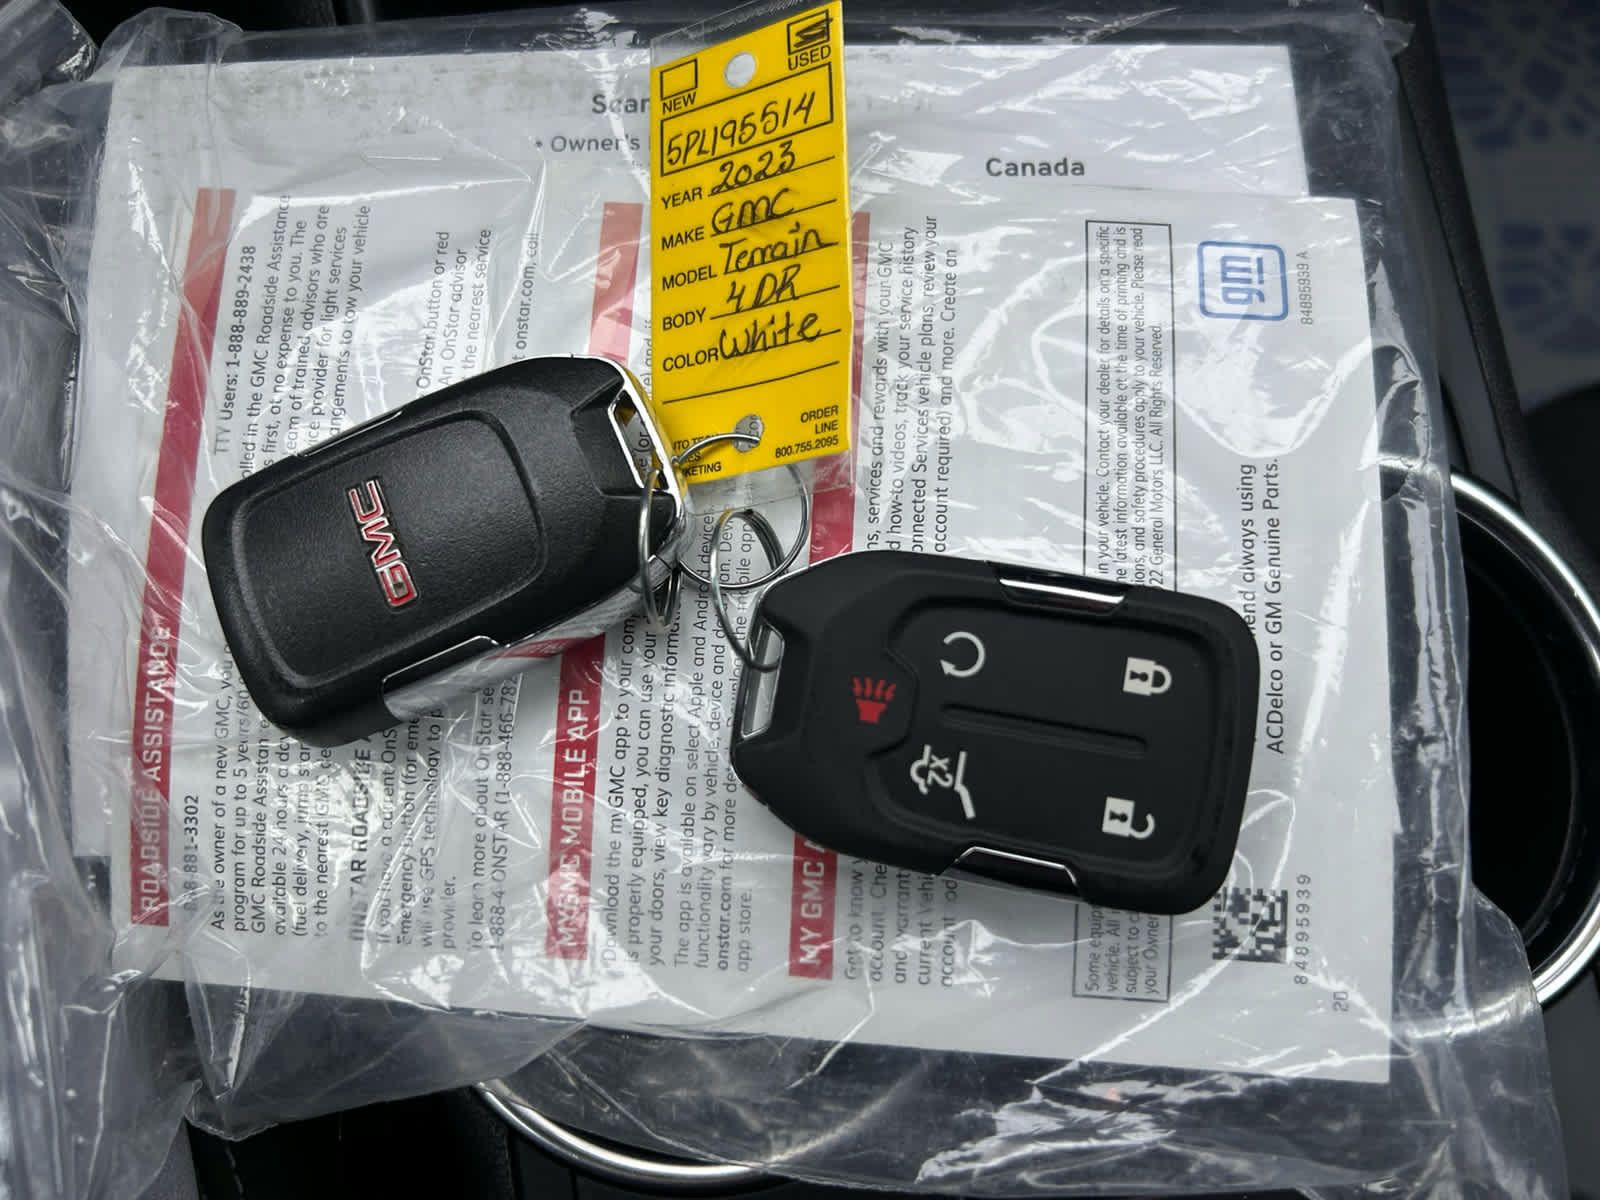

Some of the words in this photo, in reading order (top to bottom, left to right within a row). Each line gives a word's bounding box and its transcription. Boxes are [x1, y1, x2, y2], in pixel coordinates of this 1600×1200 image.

[788, 46, 832, 71] USED
[662, 92, 696, 114] NEW
[711, 141, 795, 195] 2023
[986, 157, 1085, 177] Canada
[316, 206, 330, 230] are
[661, 187, 702, 210] YEAR
[712, 189, 794, 234] GMC
[267, 195, 291, 272] Assistance
[308, 234, 327, 265] who
[351, 206, 371, 255] vehicle
[662, 229, 705, 251] MAKE
[720, 223, 836, 275] Terrain
[900, 226, 918, 275] history
[925, 216, 939, 248] your
[1096, 226, 1112, 265] specific
[329, 227, 348, 285] services
[346, 259, 364, 292] your
[471, 229, 492, 279] service
[878, 242, 893, 278] GMC
[922, 250, 937, 297] review
[1129, 255, 1144, 289] Please
[300, 269, 322, 331] advisors
[424, 279, 445, 329] button
[435, 232, 450, 255] red
[662, 266, 717, 290] MODEL
[727, 282, 744, 312] 4
[754, 264, 801, 307] DR
[940, 272, 957, 322] Create
[1113, 263, 1130, 306] printing
[1219, 255, 1265, 305] gm
[226, 245, 257, 368] 1-888-889-2438
[256, 276, 279, 345] Roadside
[320, 288, 339, 322] light
[440, 307, 460, 361] OnStar
[452, 249, 468, 303] advisor
[467, 283, 485, 340] nearest
[513, 261, 537, 350] onstar.com,
[662, 309, 706, 331] BODY
[899, 279, 914, 330] service
[919, 303, 936, 346] plans,
[1097, 297, 1111, 335] details
[264, 420, 281, 453] first,
[276, 307, 296, 369] expense
[290, 221, 308, 247] The
[719, 312, 821, 359] White
[874, 321, 890, 353] with
[898, 336, 913, 369] your
[942, 327, 955, 370] more.
[1114, 324, 1128, 351] time
[1148, 322, 1163, 378] Reserved.
[251, 349, 269, 388] GMC
[290, 335, 311, 389] trained
[663, 348, 718, 372] COLOR
[916, 351, 932, 404] vehicle
[219, 373, 239, 421] Users:
[246, 392, 264, 417] the
[312, 352, 332, 416] provider
[872, 358, 888, 420] rewards
[893, 375, 909, 414] track
[939, 376, 953, 406] and
[1131, 380, 1149, 413] apply
[1148, 381, 1166, 418] Rights
[801, 405, 838, 424] ORDER
[815, 419, 838, 434] LINE
[1113, 394, 1129, 449] available
[214, 426, 231, 455] TTY
[776, 435, 838, 458] 800.755.2095
[869, 425, 885, 456] and
[890, 419, 908, 473] videos,
[913, 409, 929, 473] Services
[935, 411, 953, 482] required)
[1095, 429, 1111, 477] Contact
[1131, 416, 1148, 483] procedures
[867, 461, 883, 524] services
[887, 478, 904, 534] how-to
[1095, 481, 1110, 527] vehicle.
[1113, 452, 1128, 524] information
[1130, 486, 1148, 523] safety
[1149, 469, 1164, 513] Motors
[1237, 463, 1257, 512] using
[1262, 458, 1280, 510] Parts.
[348, 480, 418, 607] GMC
[1113, 528, 1128, 564] latest
[1131, 527, 1145, 551] and
[1149, 517, 1164, 566] General
[1237, 518, 1258, 583] always
[1264, 517, 1281, 594] Genuine
[1265, 601, 1282, 635] GM
[642, 631, 658, 668] your
[691, 636, 707, 667] and
[709, 644, 725, 675] and
[1268, 642, 1284, 662] or
[618, 659, 635, 698] your
[640, 674, 654, 703] use
[686, 672, 705, 718] Apple
[143, 626, 170, 781] ASSISTANCE
[567, 688, 590, 741] APP
[638, 709, 652, 741] can
[707, 680, 724, 731] device
[1265, 669, 1284, 754] ACDelco
[615, 727, 630, 760] app
[656, 693, 676, 782] diagnostic
[683, 724, 701, 770] select
[216, 745, 228, 780] new
[636, 747, 652, 778] you
[704, 736, 721, 797] vehicle,
[212, 799, 226, 818] of
[559, 748, 587, 846] MOBILE
[654, 788, 672, 818] key
[722, 789, 738, 842] more
[491, 810, 509, 882] ONSTAR
[630, 783, 650, 868] equipped,
[652, 823, 668, 862] view
[680, 802, 696, 878] available
[699, 824, 718, 860] vary
[141, 790, 162, 913] ROADSIDE
[212, 824, 227, 874] owner
[252, 812, 267, 888] Roadside
[293, 829, 312, 897] delivery,
[316, 822, 330, 884] nearest
[421, 847, 435, 881] GPS
[473, 833, 488, 877] more
[233, 861, 249, 932] program
[274, 862, 288, 935] available
[314, 889, 329, 916] the
[627, 875, 645, 945] properly
[648, 868, 667, 921] doors,
[736, 888, 752, 934] store.
[801, 862, 825, 919] GMC
[847, 869, 864, 918] know
[252, 894, 266, 934] GMC
[602, 874, 620, 962] Download
[678, 900, 694, 933] app
[695, 867, 716, 969] functionality
[716, 876, 733, 971] onstar.com
[1294, 874, 1312, 985] 84895939
[649, 928, 667, 967] your
[674, 938, 689, 968] The
[737, 939, 754, 972] app
[800, 925, 821, 964] MY
[1085, 952, 1101, 992] Some
